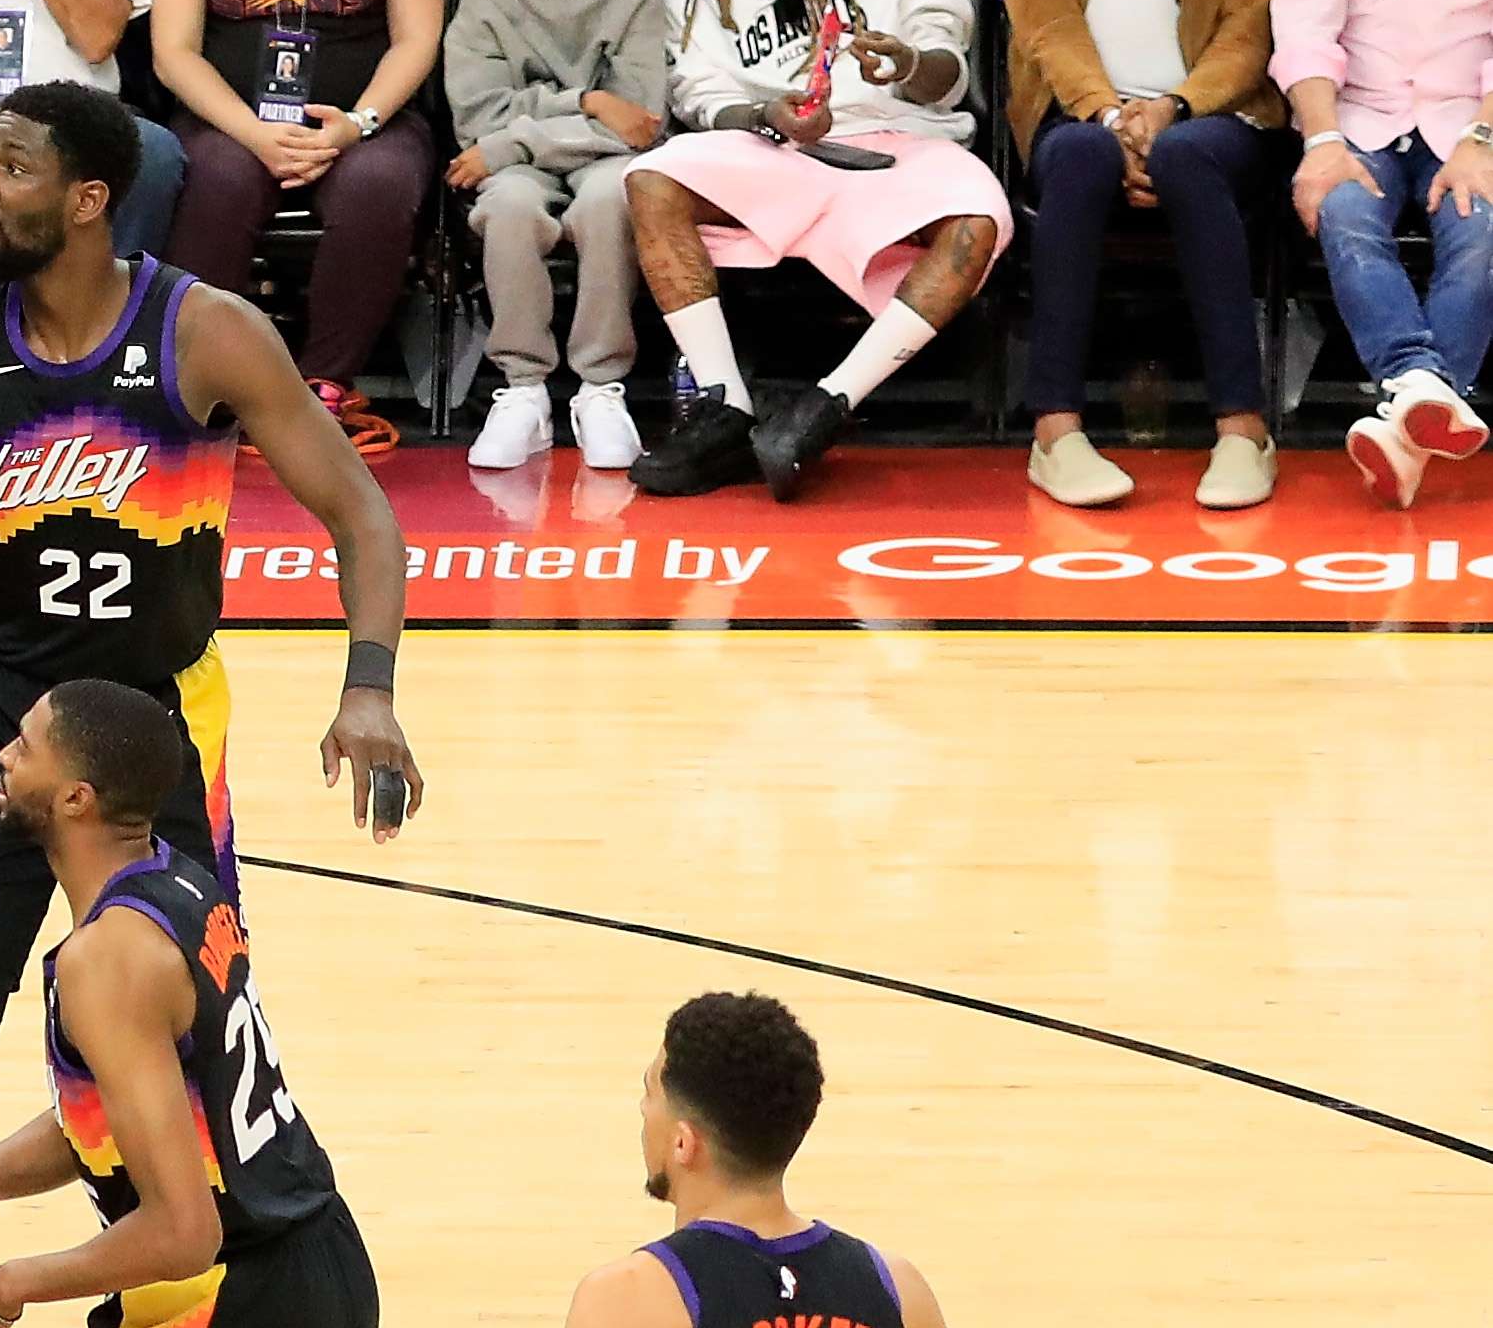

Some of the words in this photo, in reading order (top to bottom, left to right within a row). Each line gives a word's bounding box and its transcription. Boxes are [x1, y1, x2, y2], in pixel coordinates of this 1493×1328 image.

[735, 13, 774, 69] LOS
[113, 374, 155, 389] PayPal
[11, 447, 44, 466] THE
[38, 548, 132, 620] 22
[224, 538, 637, 582] resented
[663, 537, 769, 586] by
